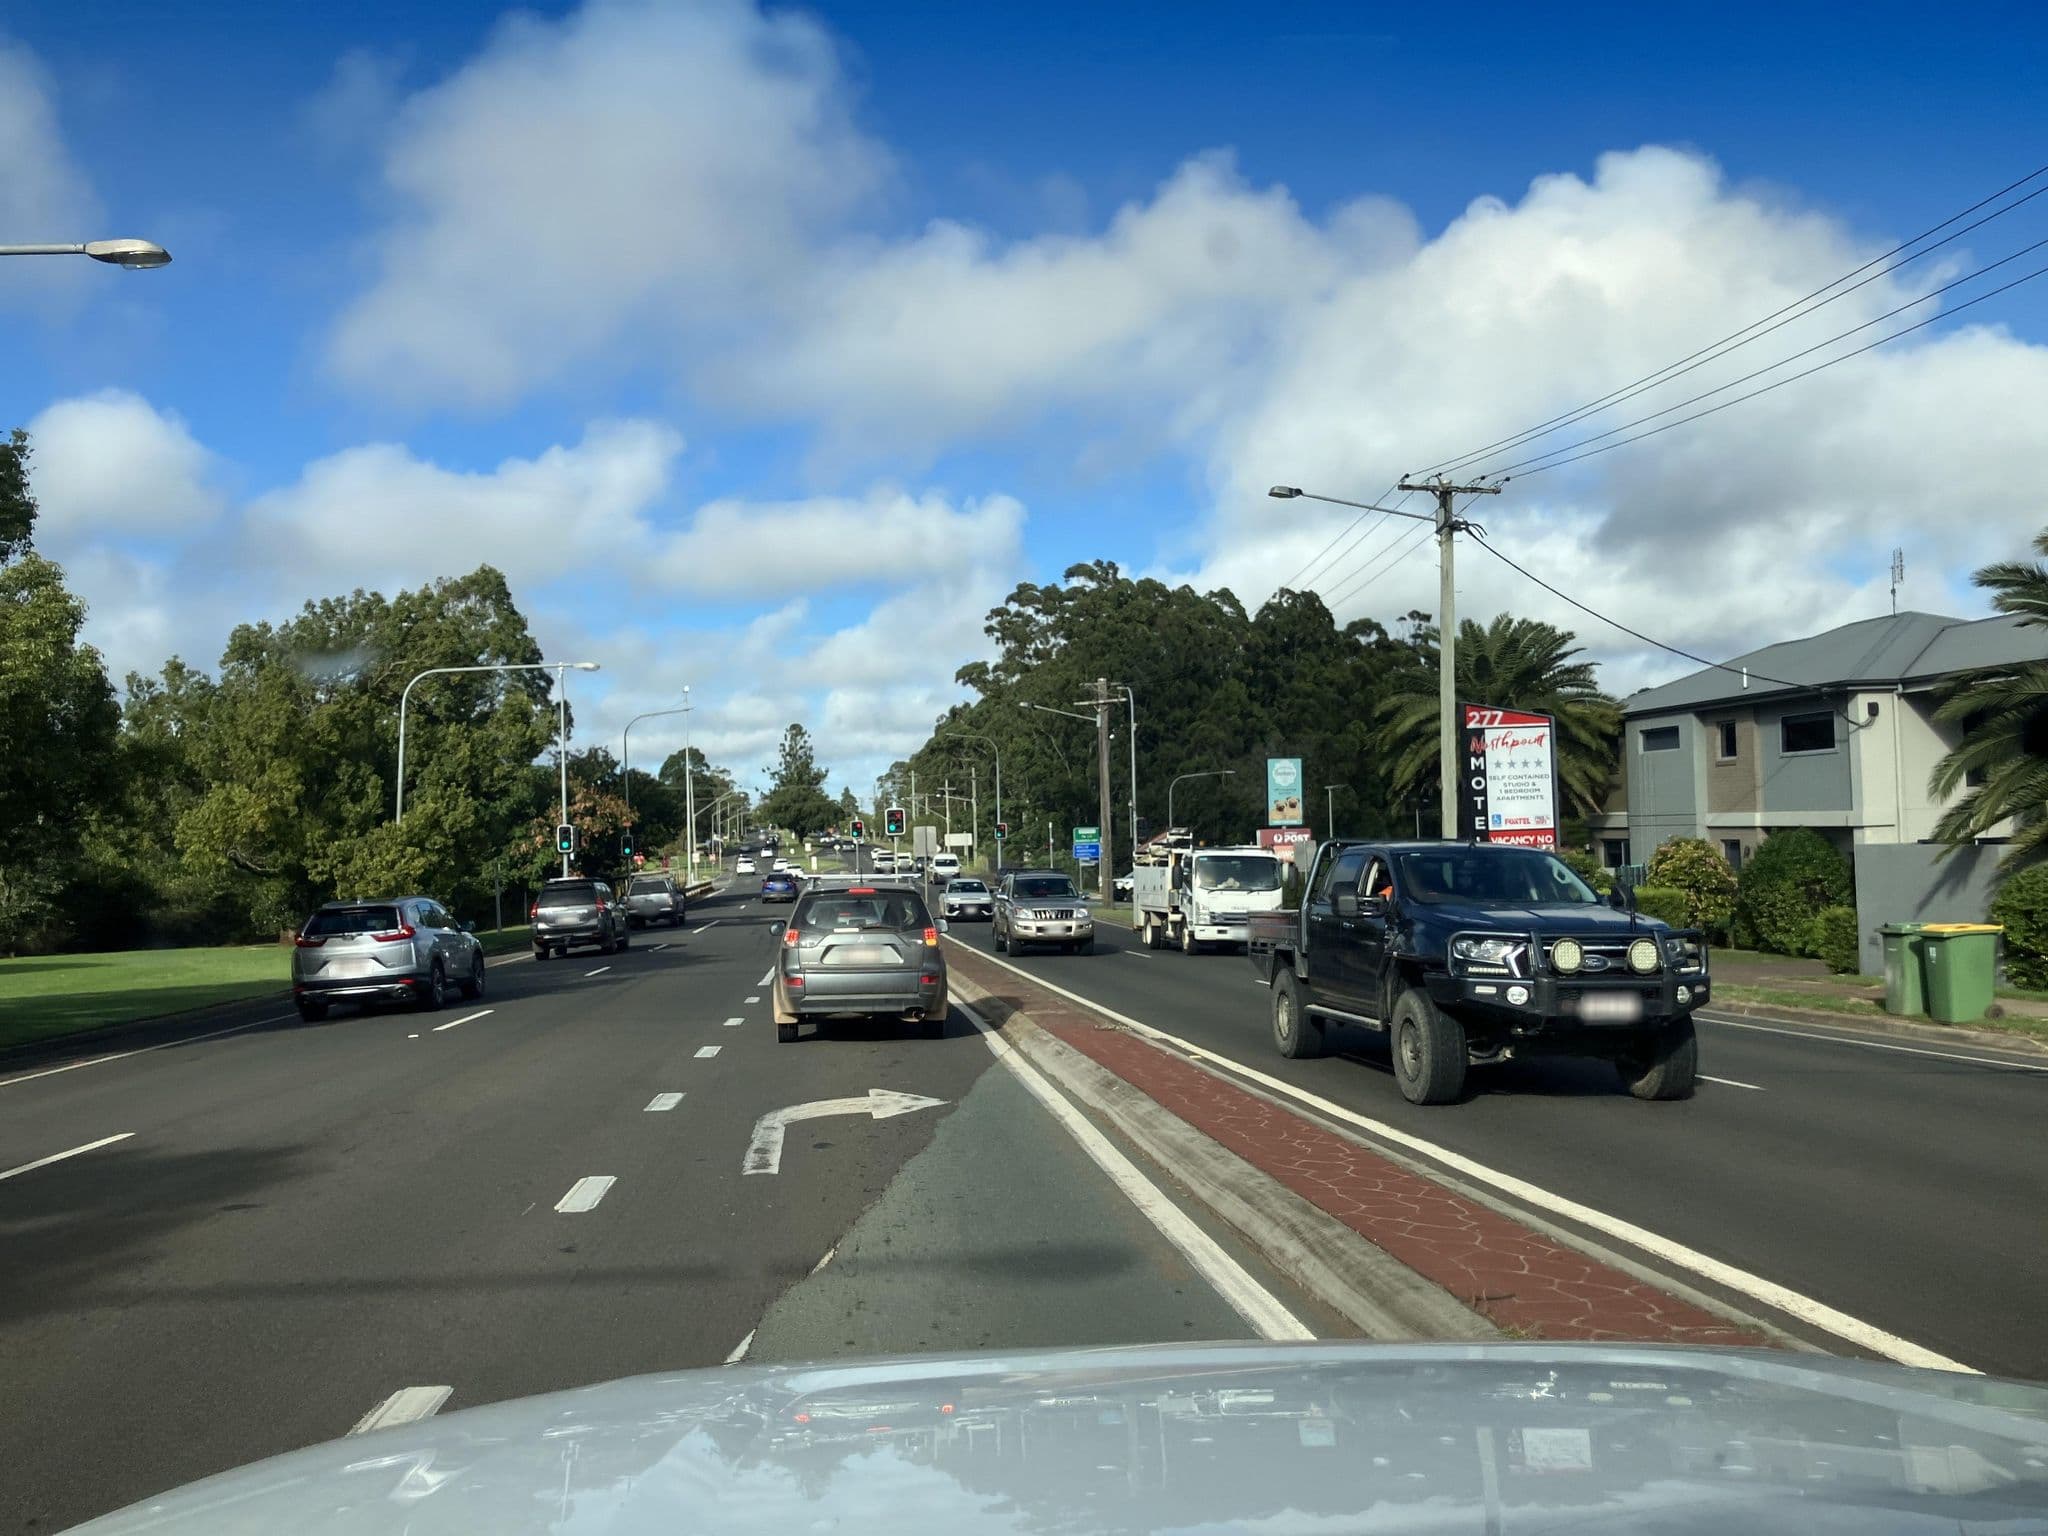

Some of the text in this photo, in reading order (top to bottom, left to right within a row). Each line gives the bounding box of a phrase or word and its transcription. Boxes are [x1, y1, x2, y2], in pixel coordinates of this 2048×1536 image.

[1468, 710, 1504, 728] 277
[1470, 730, 1546, 755] Northpoint
[1504, 817, 1531, 825] FOXTEL
[1284, 833, 1310, 843] POST
[1491, 834, 1553, 845] VACANCY NO
